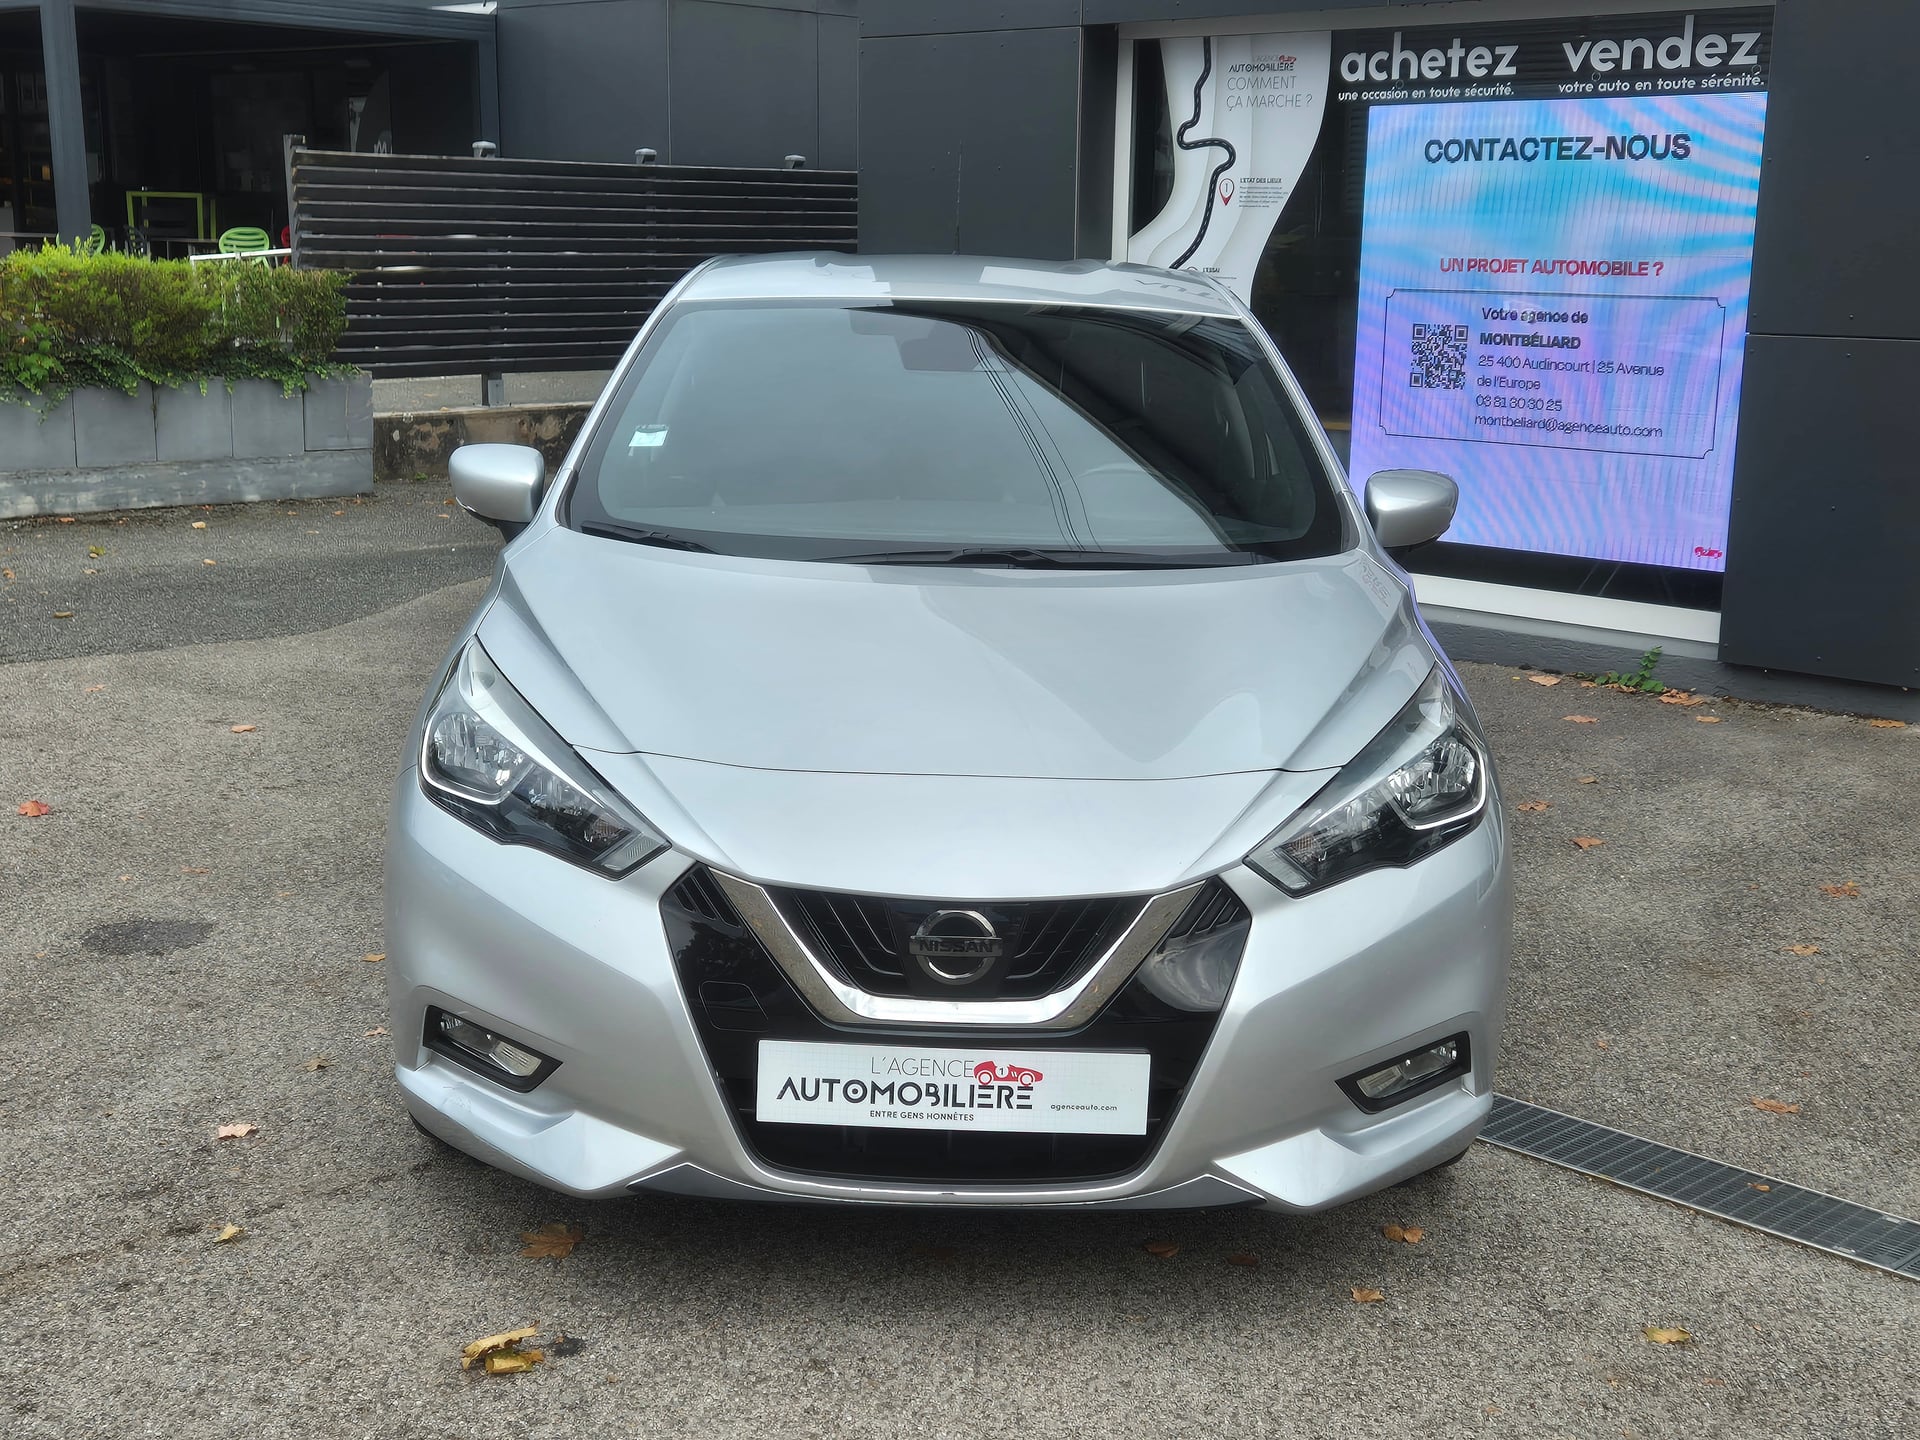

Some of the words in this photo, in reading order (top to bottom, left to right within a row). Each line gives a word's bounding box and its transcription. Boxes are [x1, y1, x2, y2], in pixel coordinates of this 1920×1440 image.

[1561, 14, 1761, 72] vendez
[1340, 31, 1519, 82] achetez
[1227, 75, 1297, 91] COMMENT
[1338, 91, 1359, 101] une
[1361, 87, 1408, 99] occasion
[1411, 88, 1426, 98] en
[1429, 85, 1461, 98] toute
[1464, 82, 1514, 97] sécurité.
[1558, 81, 1594, 93] votre
[1598, 80, 1630, 92] auto
[1635, 80, 1652, 91] en
[1657, 77, 1696, 90] toute
[1700, 71, 1765, 89] sérénité.
[1226, 94, 1243, 111] ÇA
[1246, 94, 1302, 108] MARCHE
[1305, 93, 1313, 108] ?
[1424, 133, 1692, 163] CONTACTEZ-NOUS
[1440, 257, 1464, 273] UN
[1467, 257, 1529, 275] PROJET
[1531, 259, 1649, 278] AUTOMOBILE
[1652, 261, 1665, 277] ?
[1482, 307, 1518, 321] Votre
[1520, 311, 1568, 324] agence
[1571, 310, 1589, 324] de
[1479, 331, 1581, 350] MONTBÉLIARD
[1478, 354, 1494, 367] 25
[1496, 355, 1521, 369] 400
[1522, 357, 1591, 373] Audincourt
[1597, 361, 1614, 374] 25
[1615, 362, 1665, 376] Avenue
[1476, 375, 1492, 387] de
[1494, 376, 1541, 391] l'Europe
[1545, 399, 1562, 411] 25
[919, 939, 993, 953] NISSAN
[871, 1055, 974, 1078] L'AGENCE
[870, 1110, 898, 1120] ENTRE
[899, 1111, 925, 1121] GENS
[926, 1111, 975, 1122] HONNÊTES
[1050, 1103, 1118, 1112] agenceauto.com
